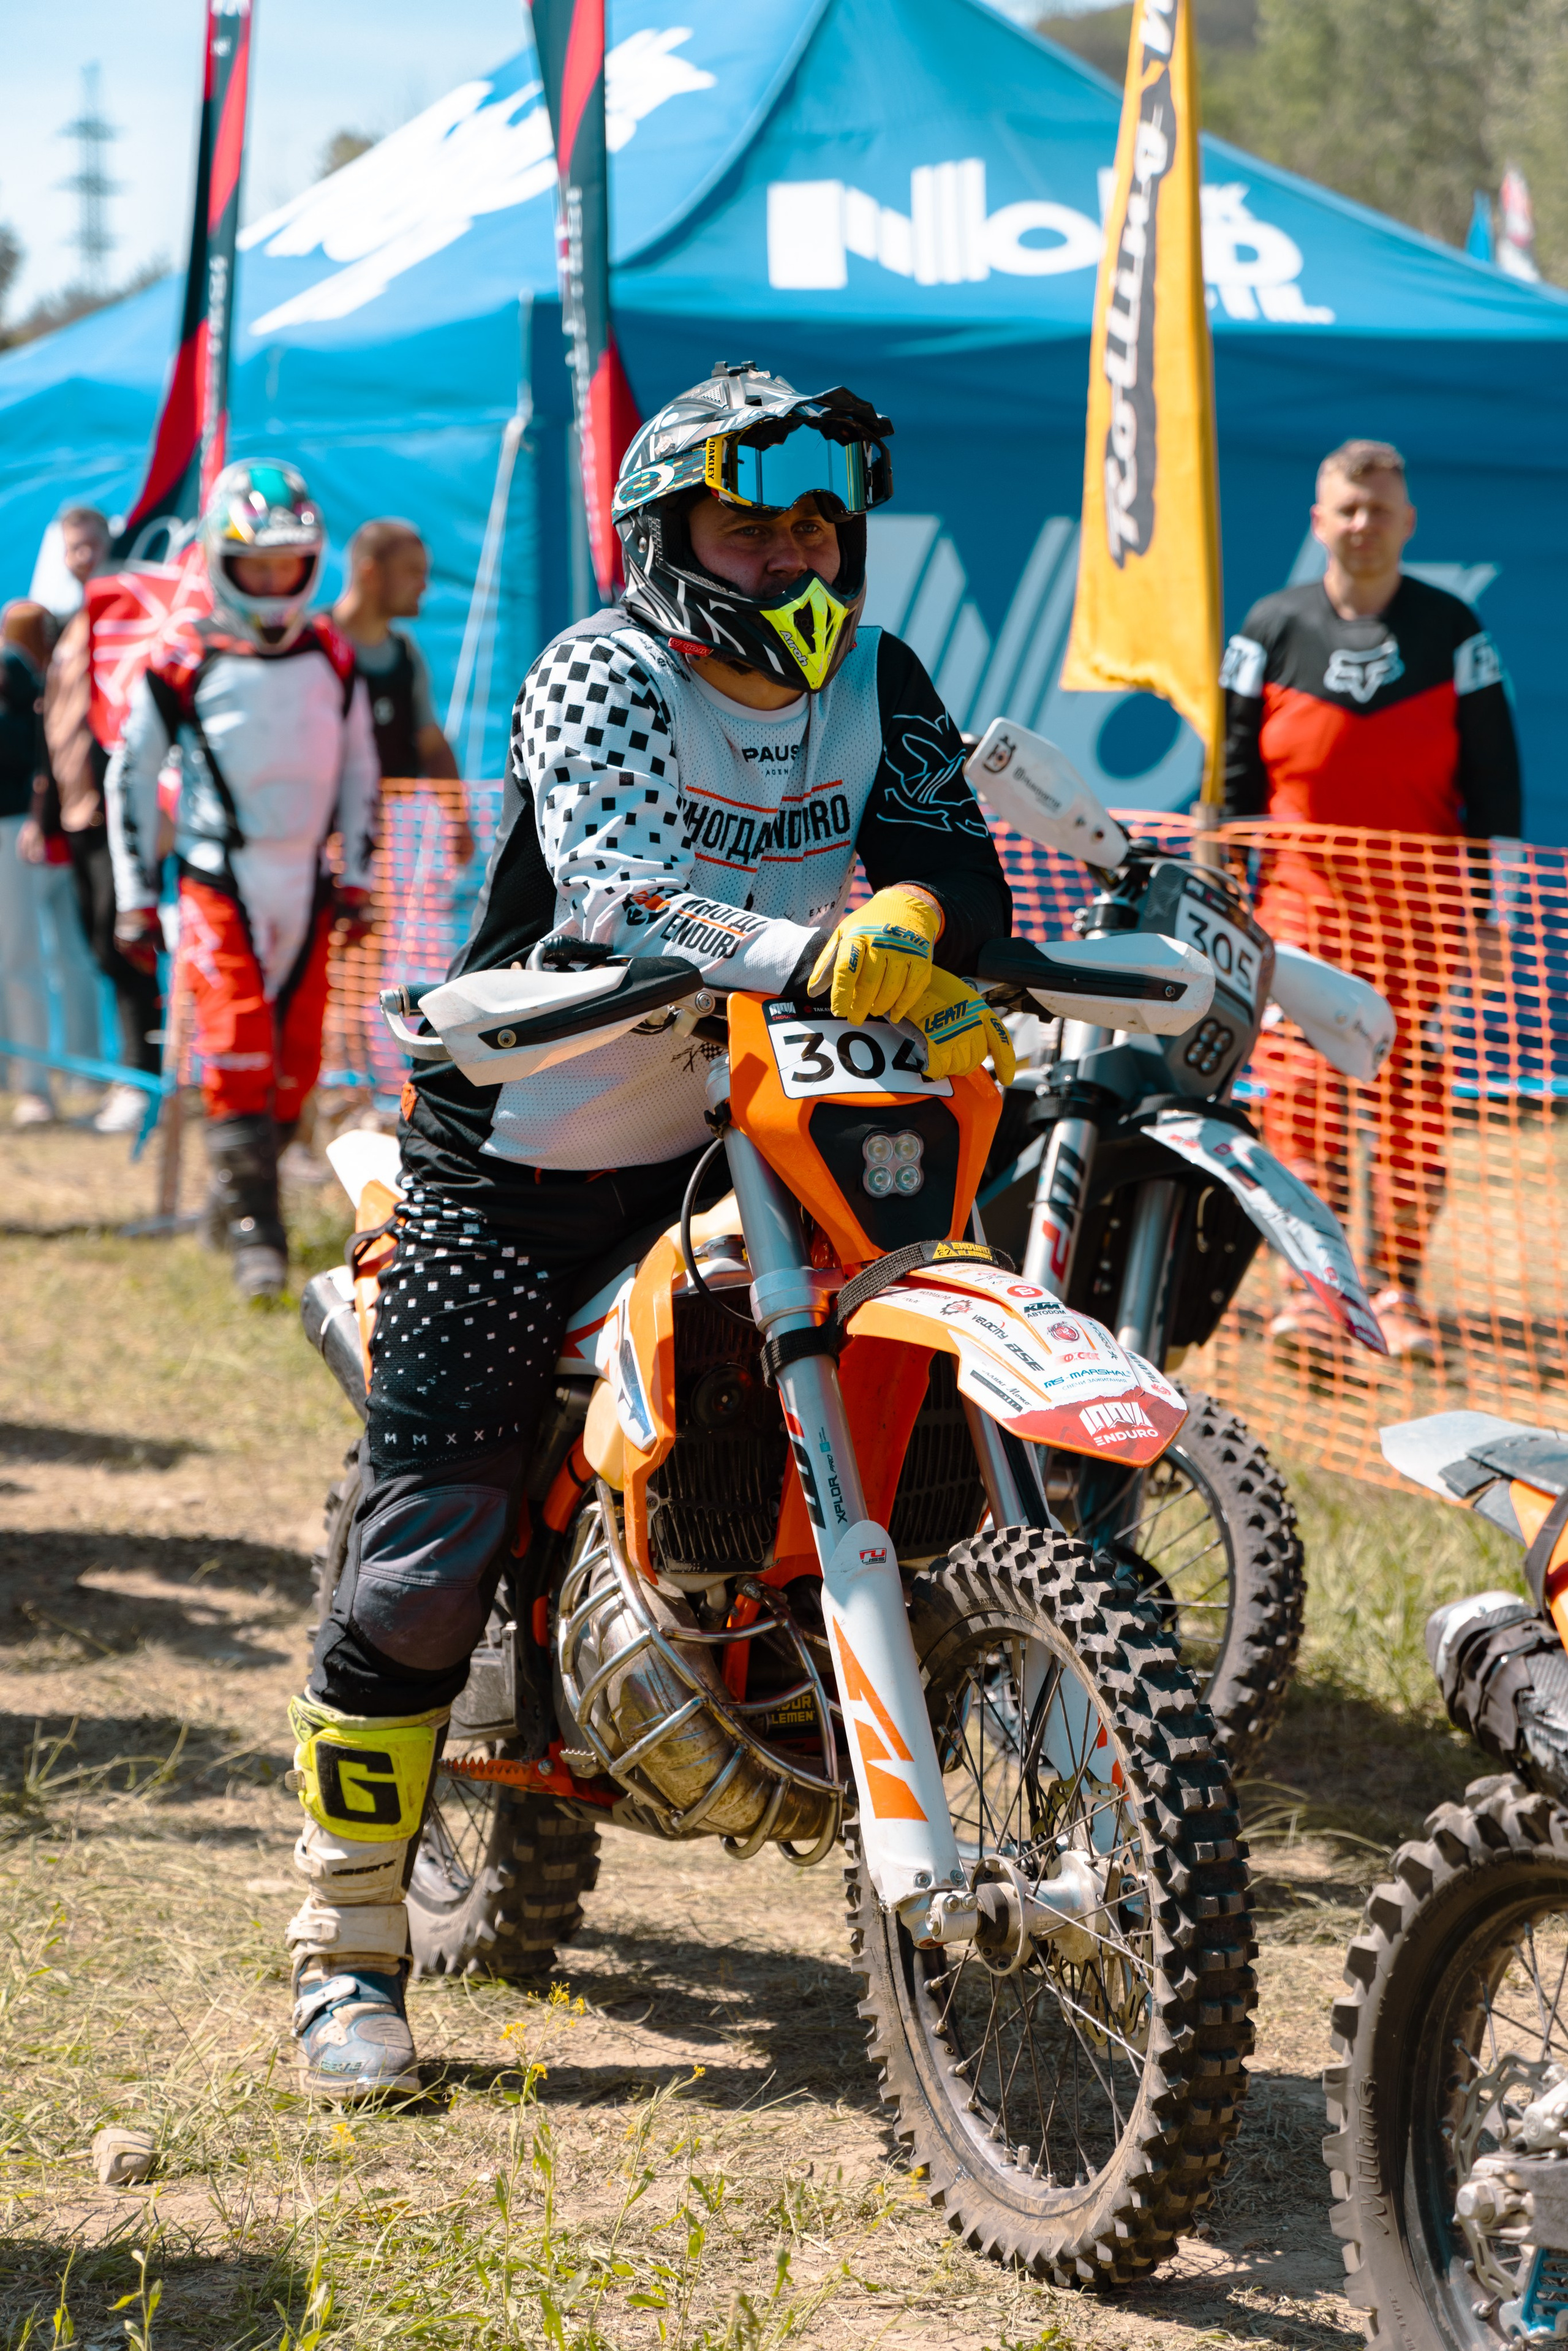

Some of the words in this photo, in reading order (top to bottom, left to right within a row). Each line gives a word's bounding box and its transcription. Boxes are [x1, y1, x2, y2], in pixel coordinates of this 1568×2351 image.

[707, 440, 716, 480] OAKLEY
[780, 630, 808, 667] Airoh
[881, 923, 930, 948] LEATT
[848, 943, 861, 974] LEATT
[1186, 910, 1261, 994] 305
[924, 999, 969, 1034] LEATT
[990, 1017, 1010, 1046] LEATT
[957, 1250, 993, 1261] ELEMENT
[1023, 1302, 1061, 1313] KTM
[971, 1314, 1009, 1340] VELOCITY
[1003, 1343, 1046, 1372] BSE
[1061, 1380, 1087, 1391] СВЕЧИ
[1093, 1428, 1159, 1447] ENDURO
[823, 1454, 835, 1474] PRO
[831, 1474, 848, 1524] XPLOR
[771, 1710, 815, 1725] LEMEN
[315, 1740, 402, 1825] G
[1355, 2074, 1390, 2236] Mitas
